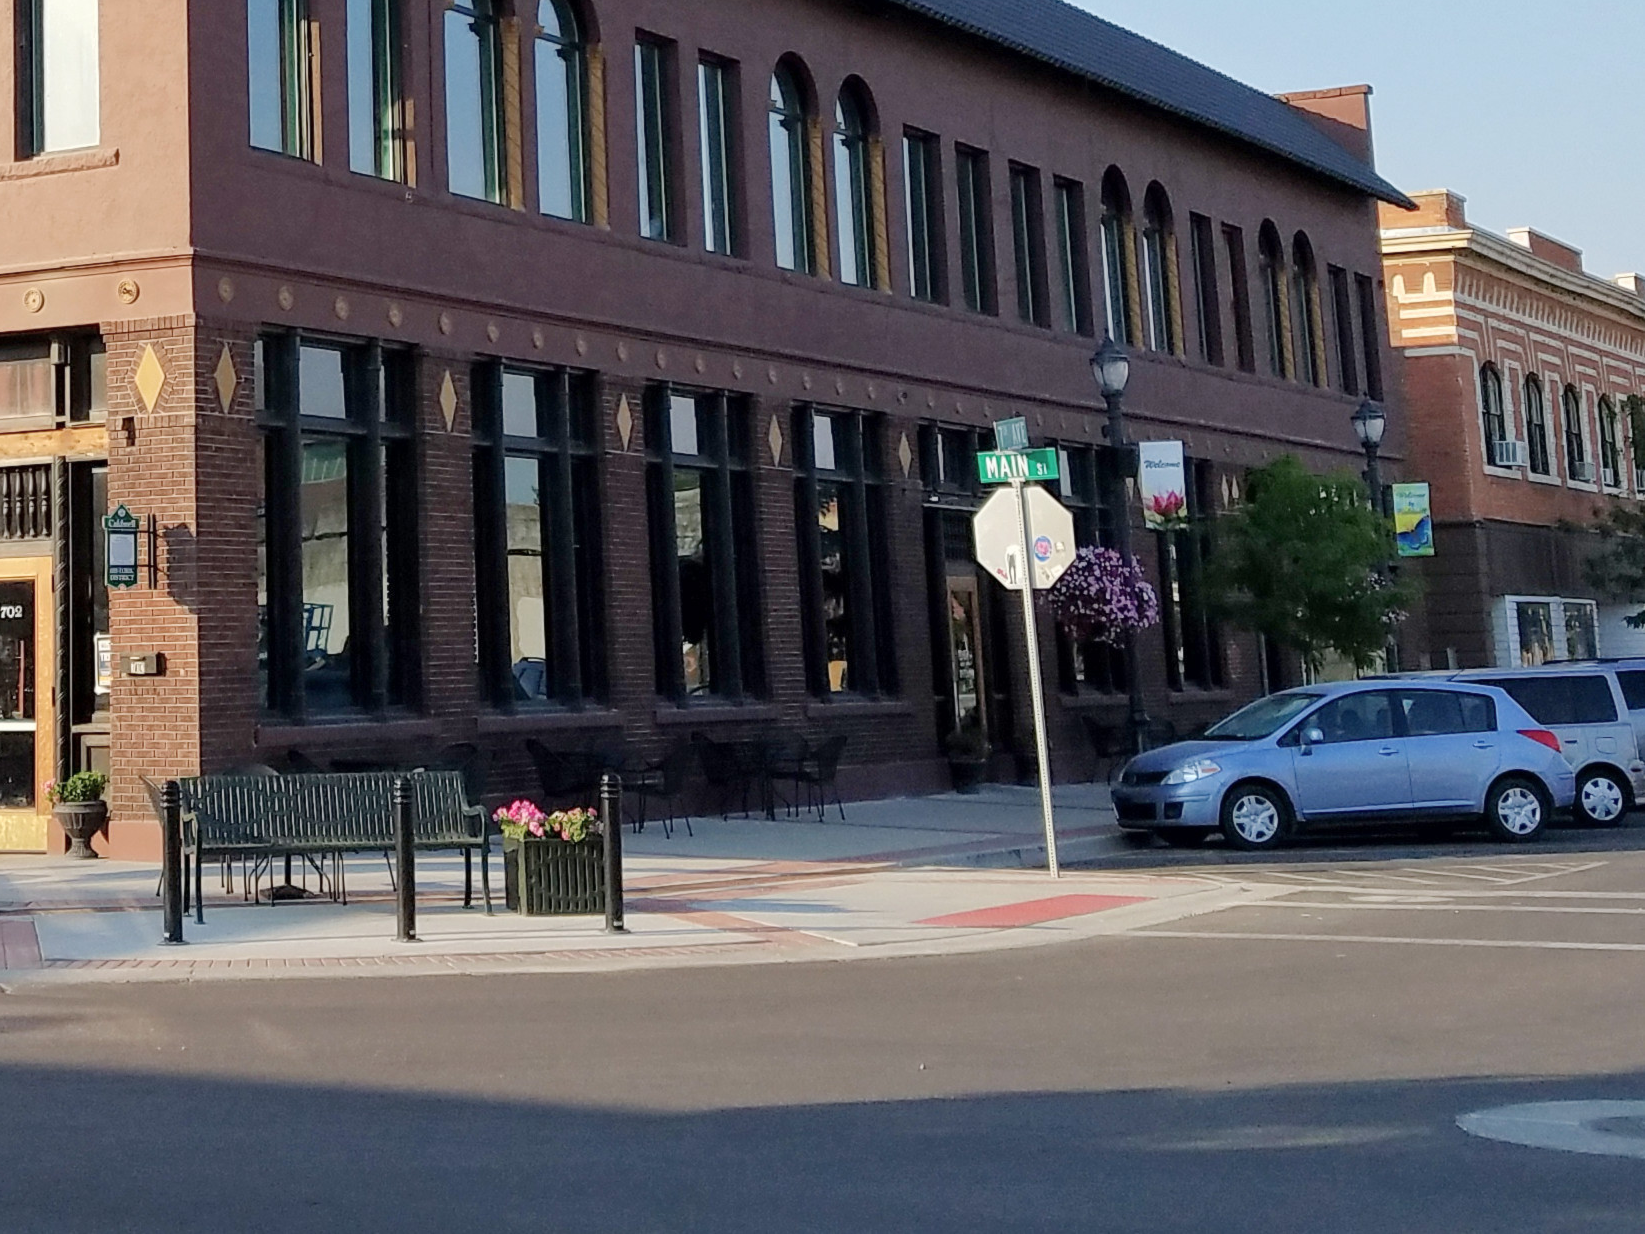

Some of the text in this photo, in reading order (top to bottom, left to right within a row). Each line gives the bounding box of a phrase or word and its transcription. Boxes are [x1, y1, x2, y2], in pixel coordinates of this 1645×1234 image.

[985, 454, 1030, 479] MAIN
[1143, 459, 1181, 470] Welcome
[0, 605, 23, 619] 702
